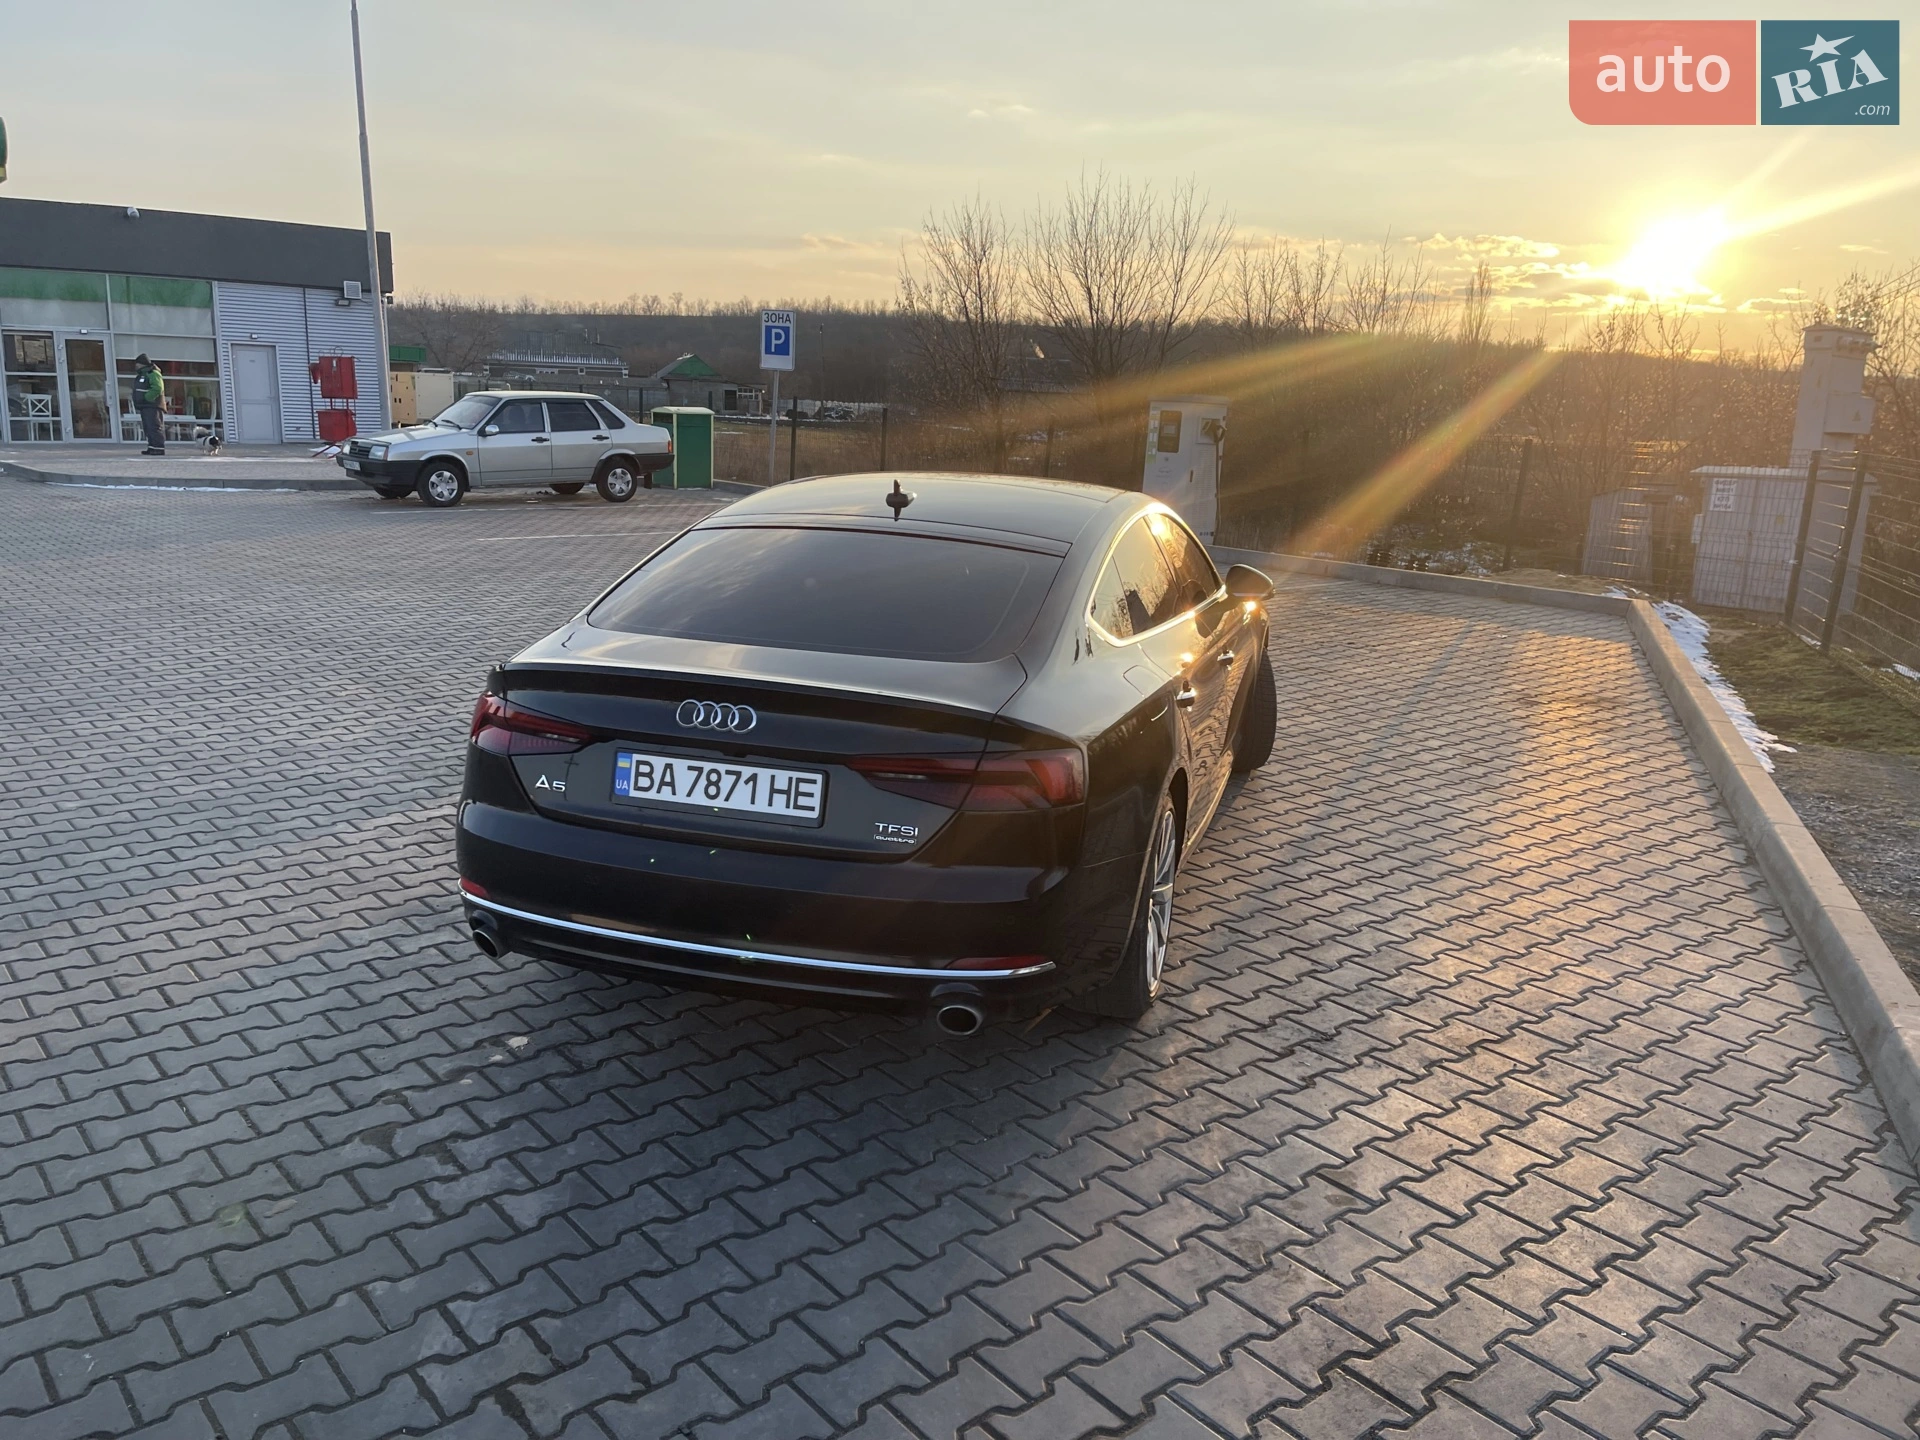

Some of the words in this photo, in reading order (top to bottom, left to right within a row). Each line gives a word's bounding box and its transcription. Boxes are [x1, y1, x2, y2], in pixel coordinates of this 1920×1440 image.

[763, 312, 792, 324] ЗОНА
[535, 774, 566, 792] A5
[616, 779, 629, 791] UA
[633, 759, 677, 796] BA
[686, 765, 758, 805] 7871
[768, 774, 818, 812] HE
[875, 822, 919, 837] TFSI
[875, 835, 915, 844] quattro
